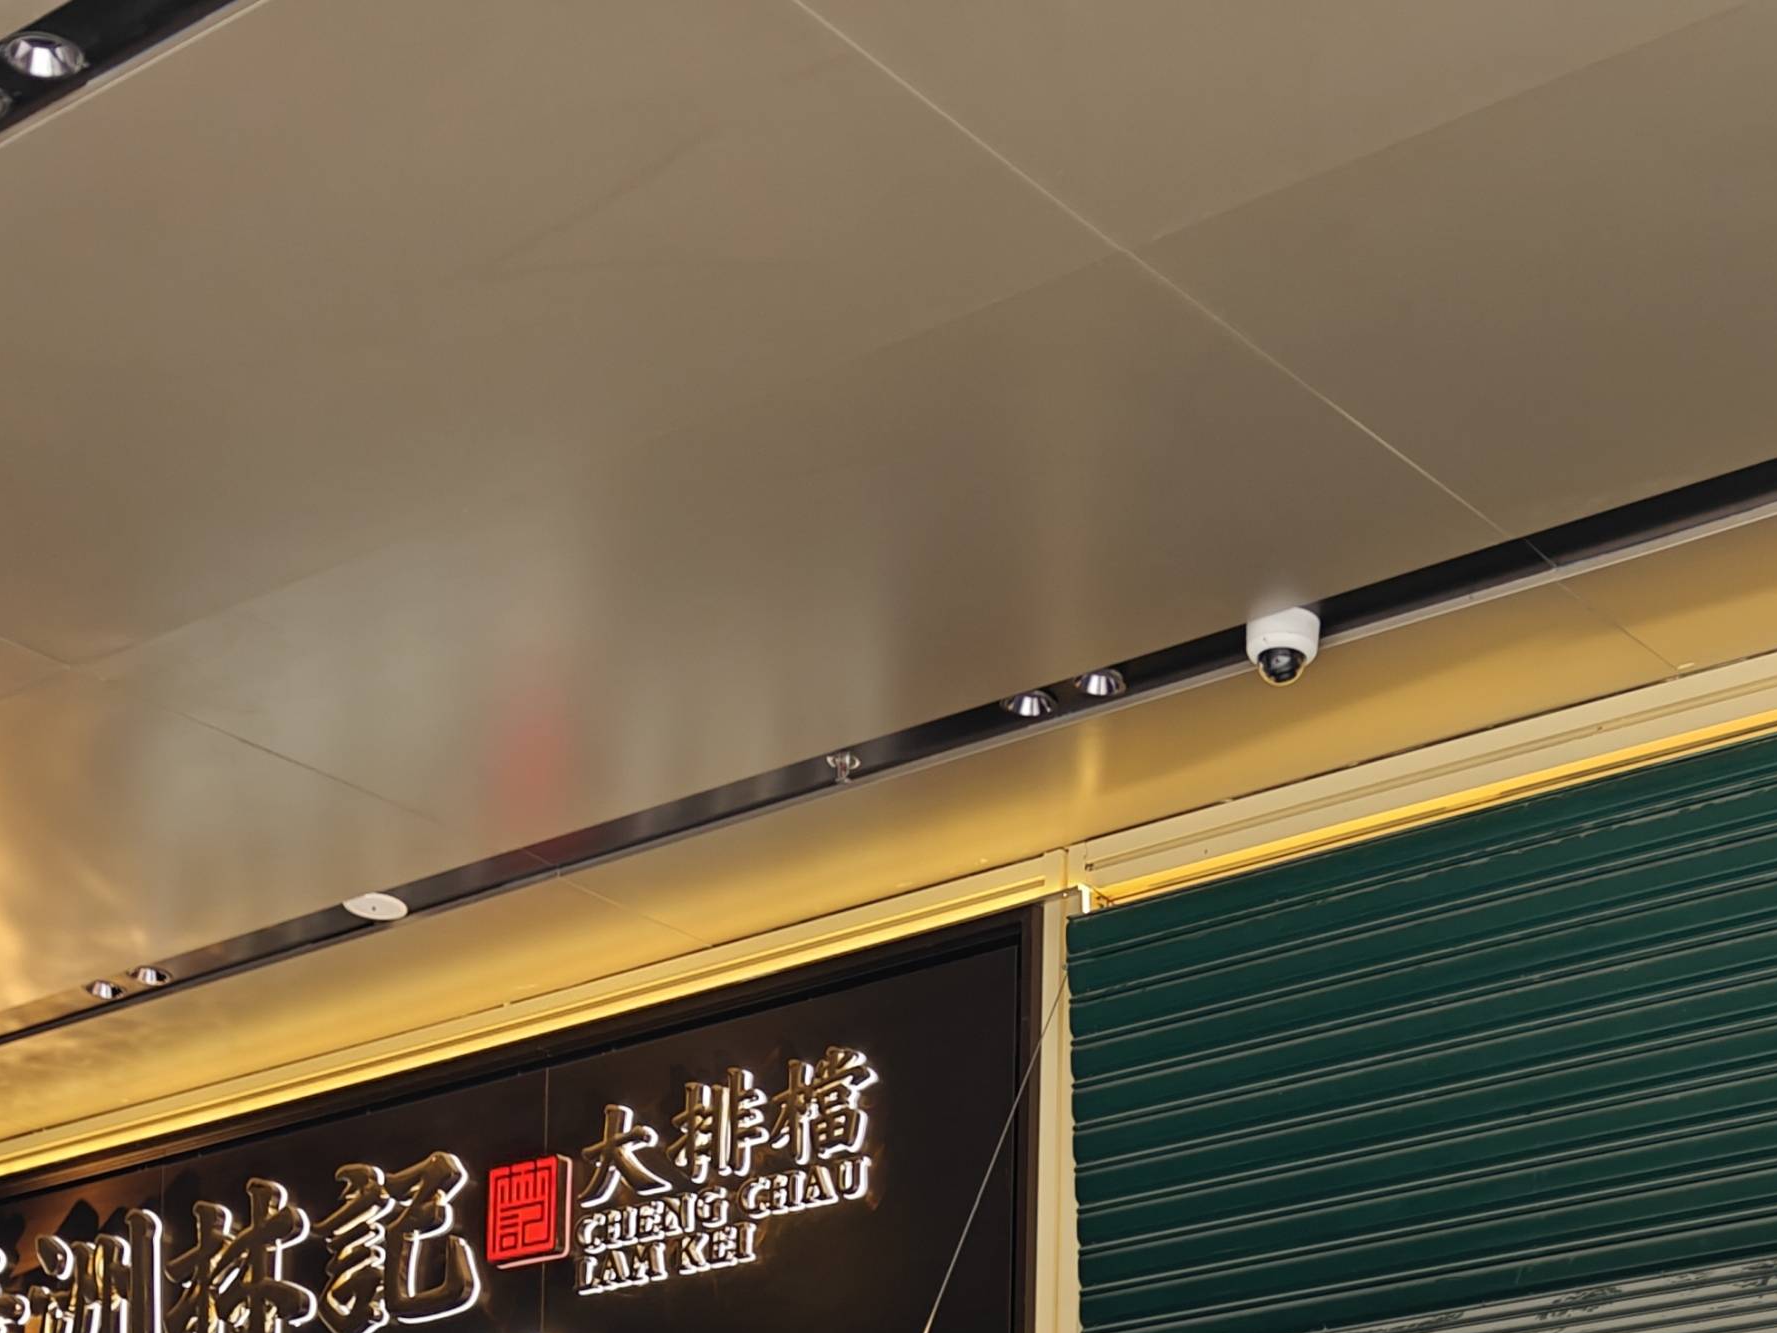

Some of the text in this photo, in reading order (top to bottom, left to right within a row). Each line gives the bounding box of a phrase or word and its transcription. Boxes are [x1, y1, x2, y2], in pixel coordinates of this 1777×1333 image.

[576, 1155, 873, 1254] CHENG CHAU
[575, 1222, 758, 1296] LAM KEI
